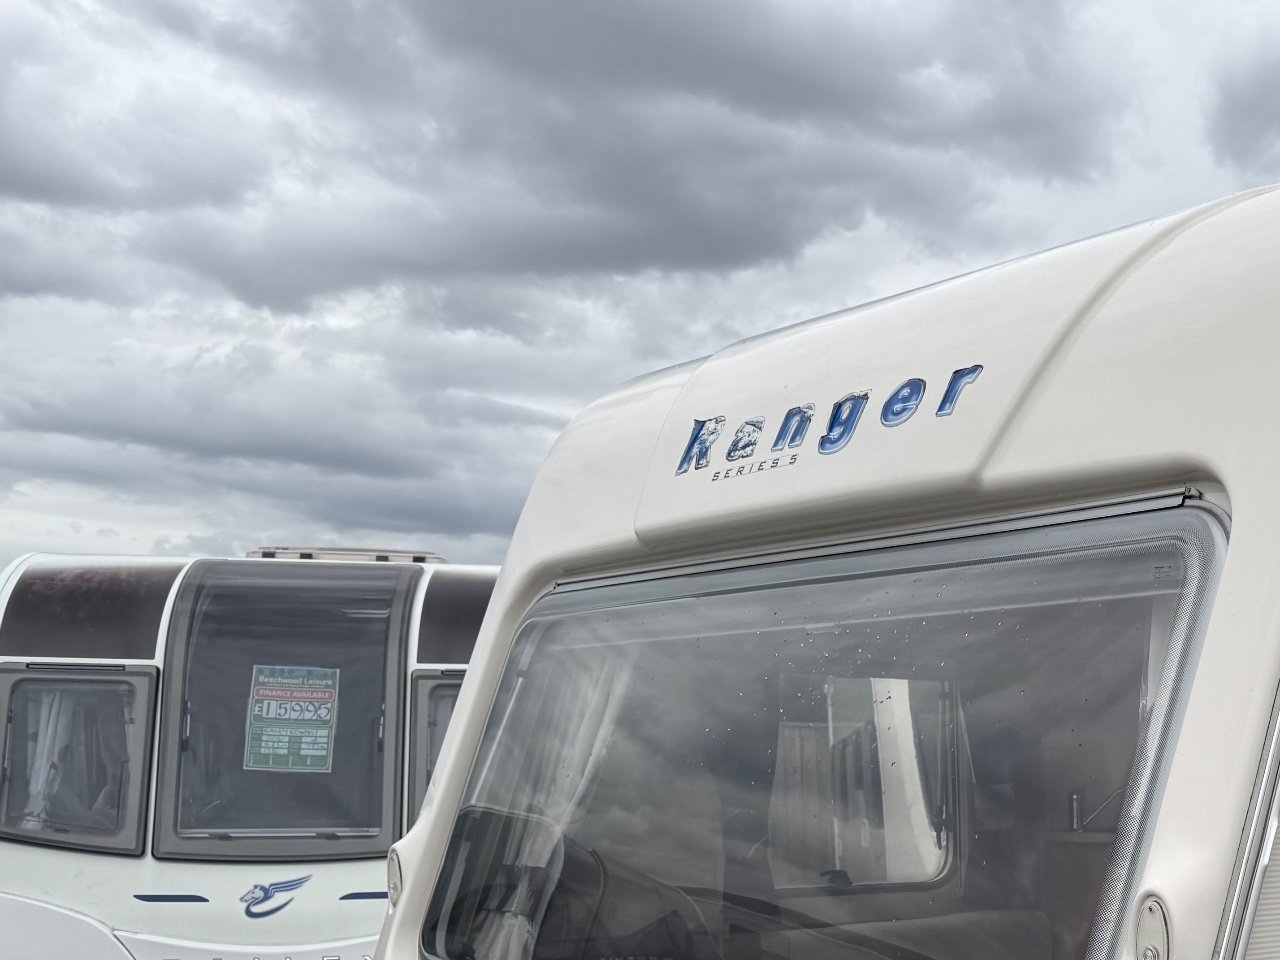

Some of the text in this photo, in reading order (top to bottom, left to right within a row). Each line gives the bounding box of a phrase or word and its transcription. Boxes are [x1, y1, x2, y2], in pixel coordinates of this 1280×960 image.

[675, 364, 984, 476] Ranger
[711, 453, 799, 482] SERIES 5
[258, 675, 302, 684] Beechwood
[304, 677, 333, 686] Leisure
[259, 689, 330, 699] FINANCE AVAILABLE
